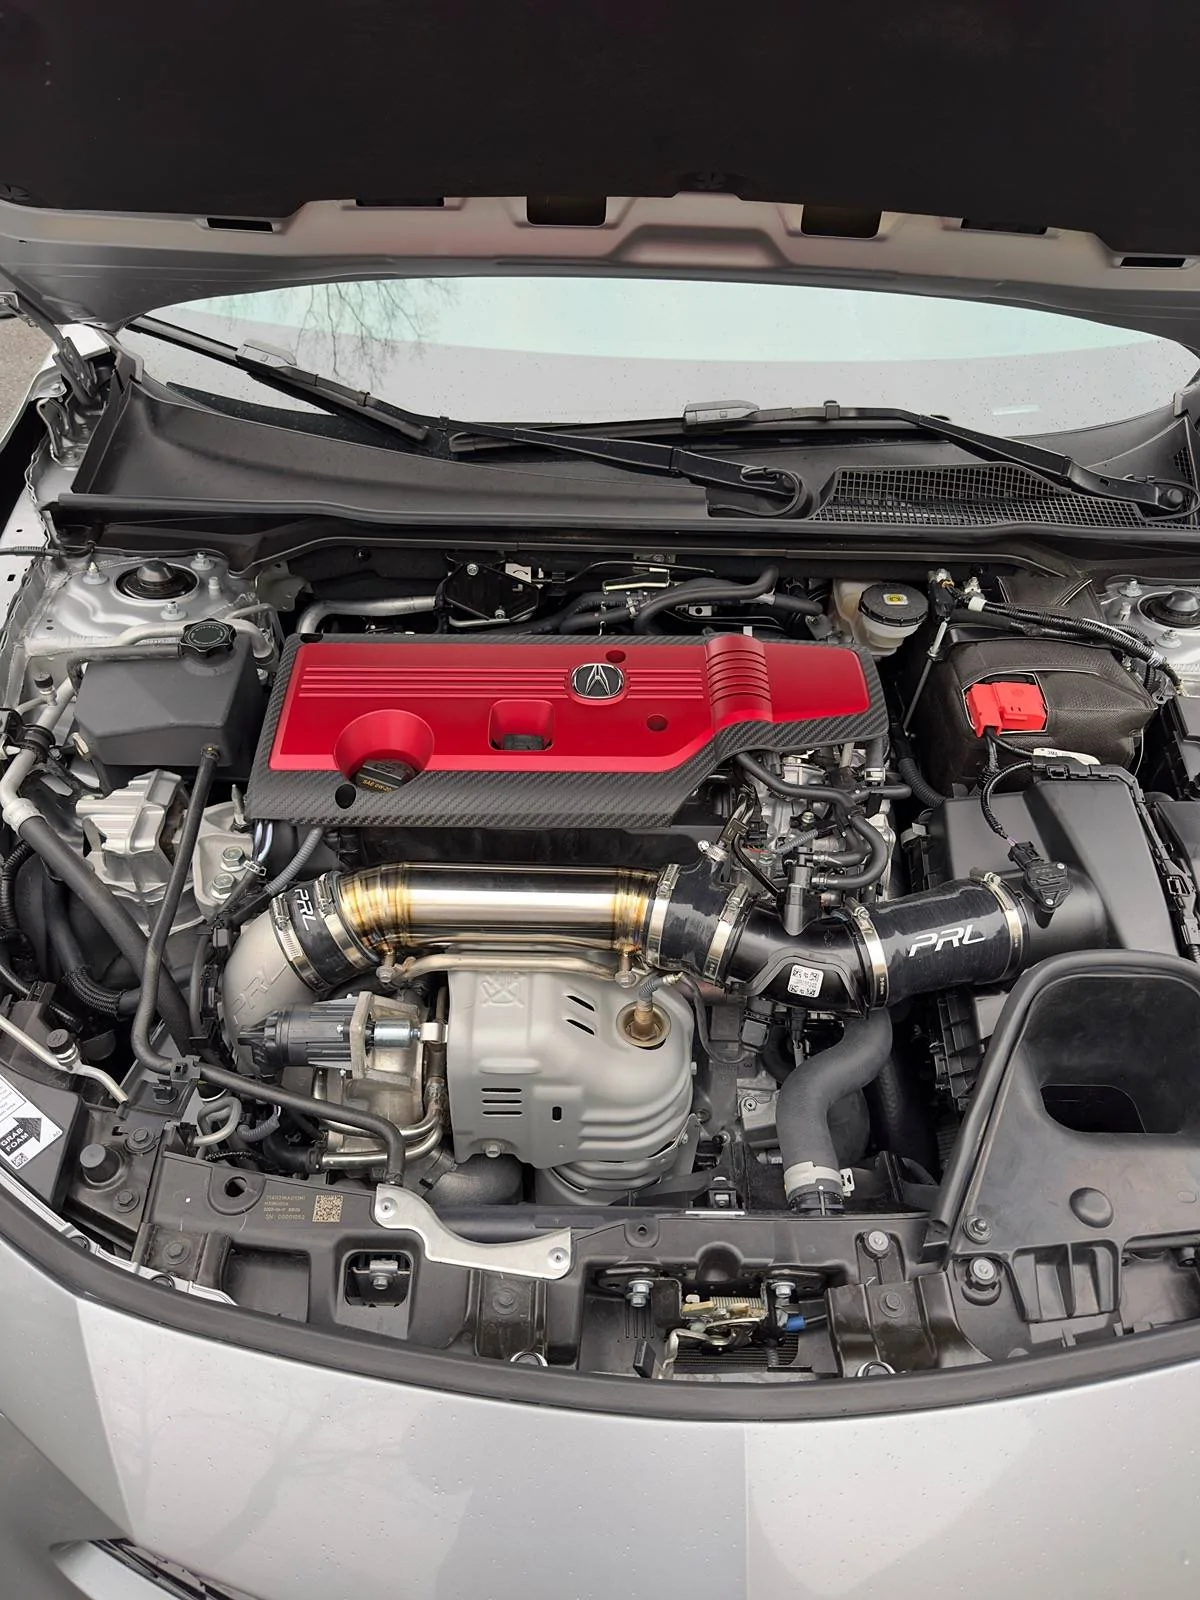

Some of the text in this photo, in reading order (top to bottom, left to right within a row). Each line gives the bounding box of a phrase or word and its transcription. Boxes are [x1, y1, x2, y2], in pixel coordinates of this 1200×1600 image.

[294, 888, 317, 931] PRL
[908, 924, 986, 957] PRL
[1, 1127, 23, 1146] GRAB
[5, 1132, 29, 1152] FOAM
